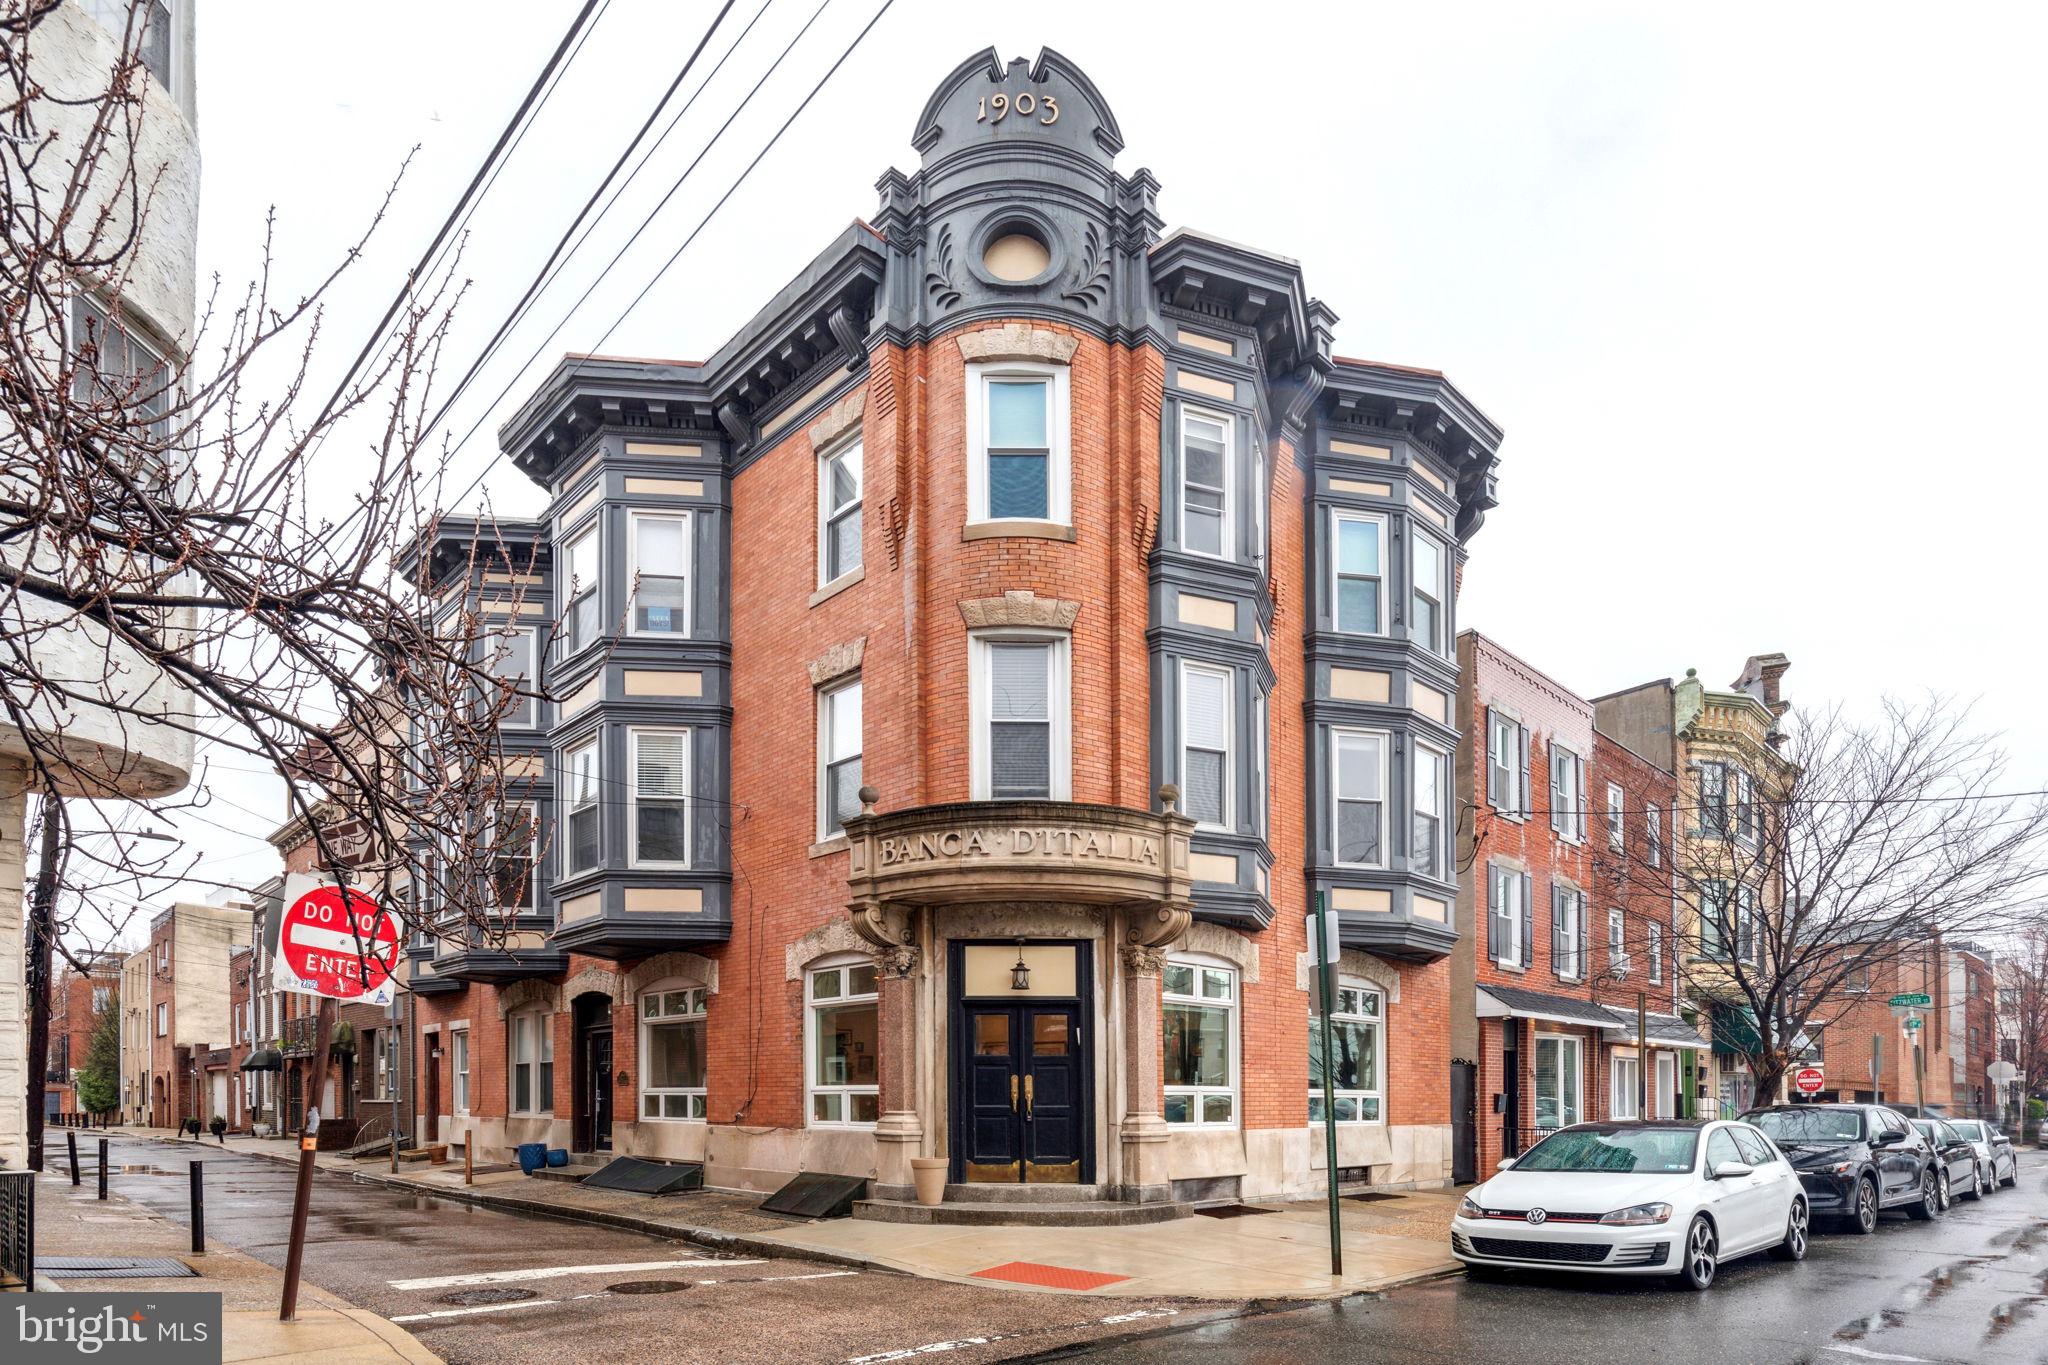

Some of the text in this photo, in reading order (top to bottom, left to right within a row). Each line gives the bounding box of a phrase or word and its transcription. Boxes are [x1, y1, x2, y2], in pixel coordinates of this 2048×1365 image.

[977, 93, 1059, 124] 1903
[340, 835, 356, 855] WAY
[881, 827, 1159, 865] BANCA D'ITALIA
[304, 901, 333, 922] DO
